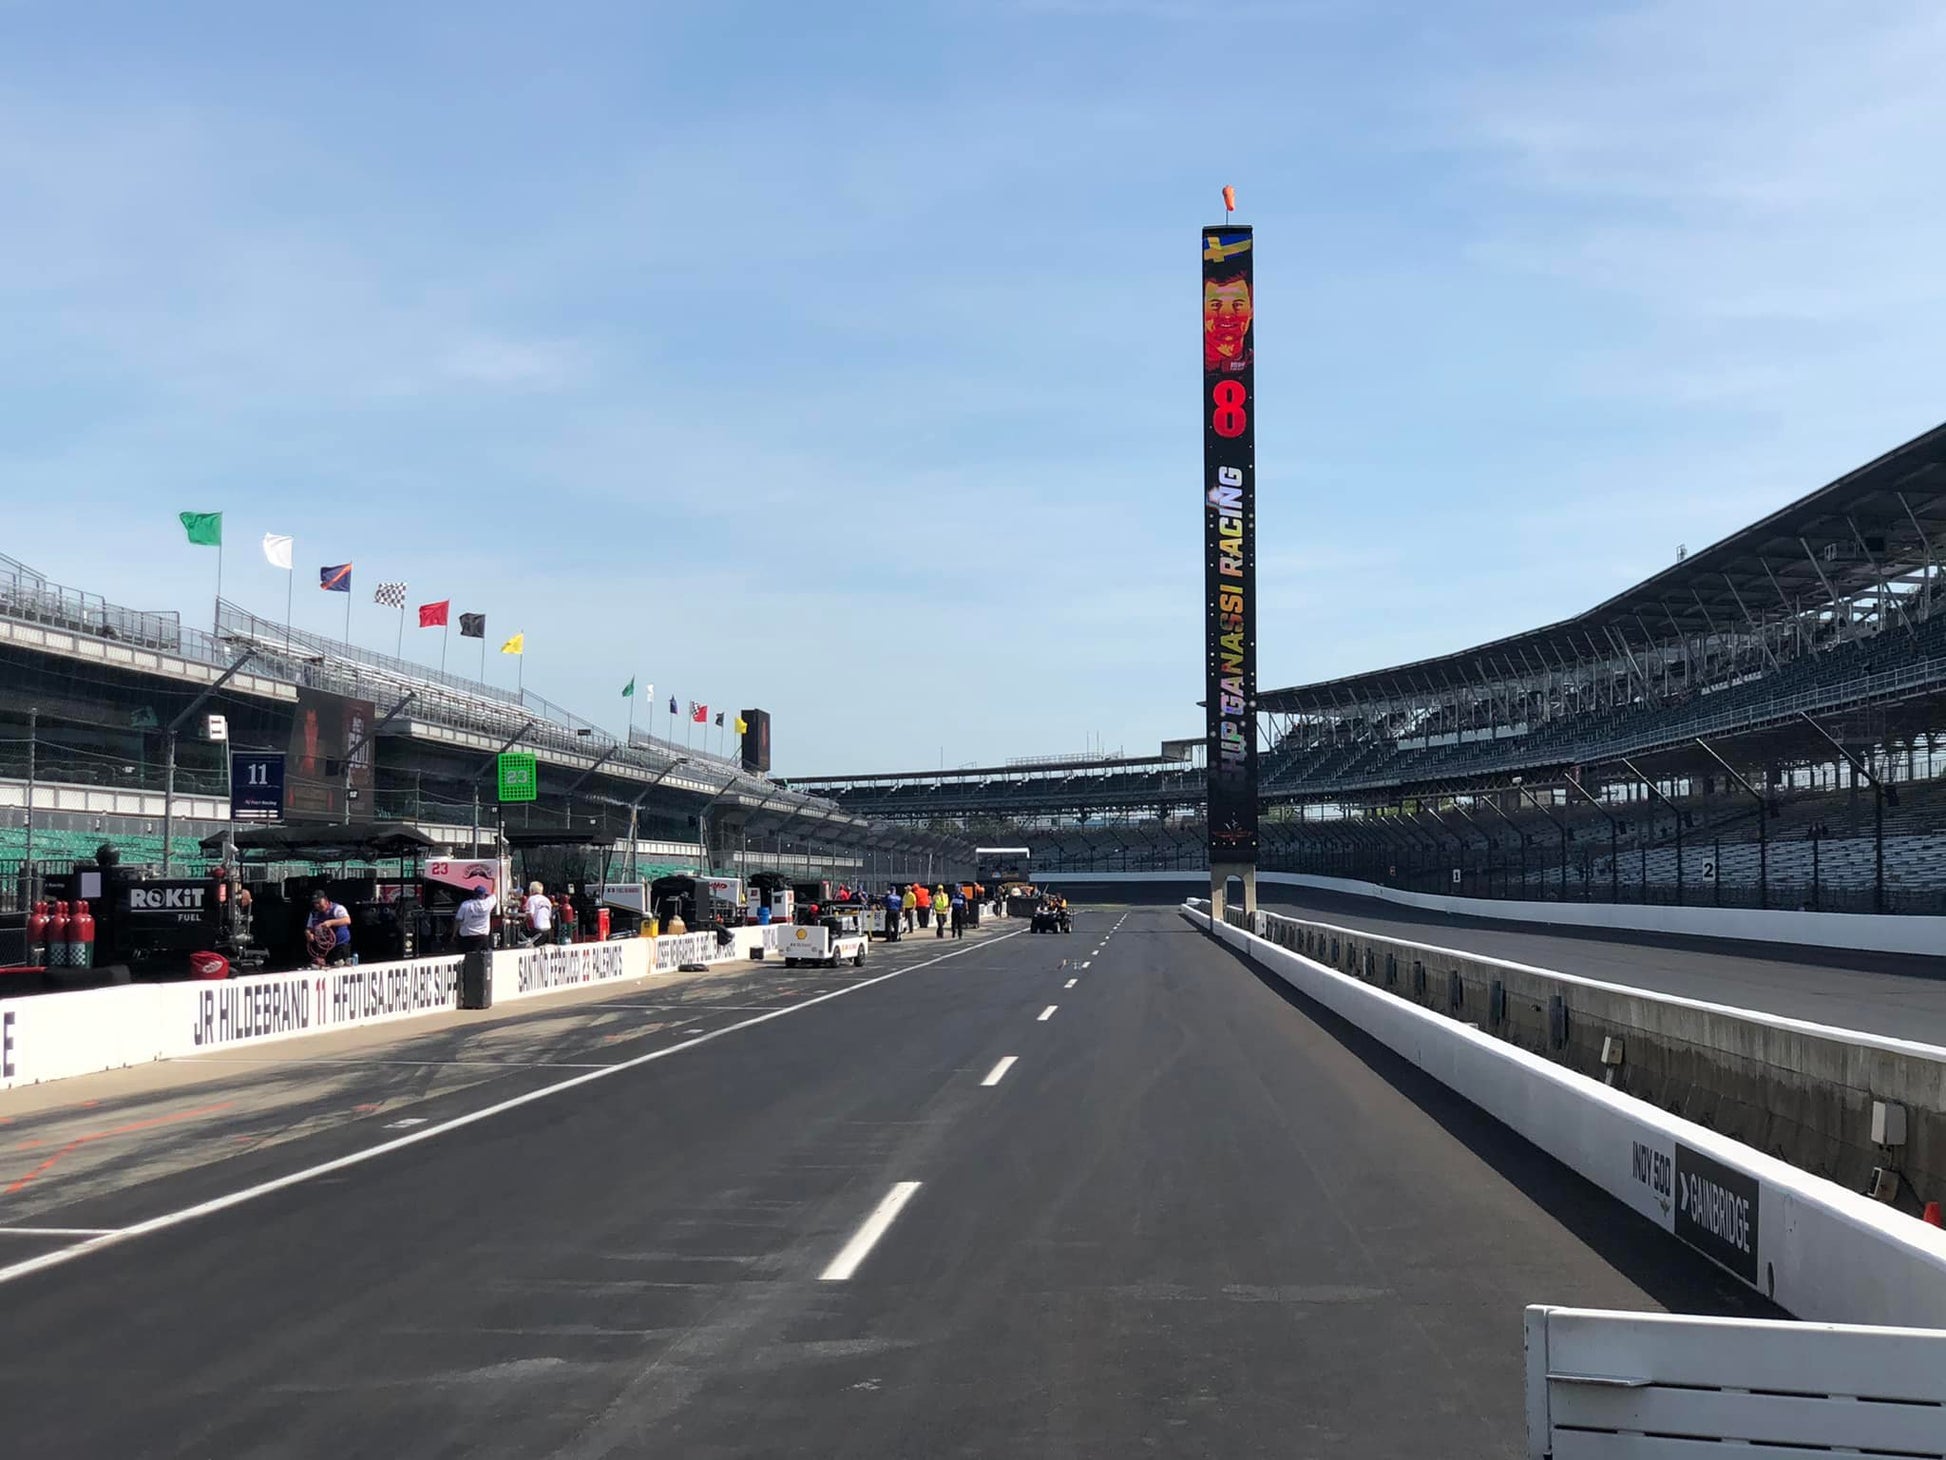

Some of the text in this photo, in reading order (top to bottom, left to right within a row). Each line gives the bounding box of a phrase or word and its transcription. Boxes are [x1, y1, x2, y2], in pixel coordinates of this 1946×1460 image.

[1213, 380, 1247, 438] 8
[1218, 466, 1243, 578] RACING
[1219, 583, 1244, 716] GANASSI
[248, 763, 268, 785] 11
[506, 770, 528, 785] 23
[432, 862, 449, 875] 23
[1704, 862, 1713, 878] 2
[130, 888, 205, 908] ROKiT
[177, 913, 202, 922] FUEL
[518, 951, 549, 993] SANTINO
[583, 949, 591, 982] 23
[194, 989, 214, 1046] JR
[219, 979, 309, 1042] HILDEBRAND
[316, 977, 327, 1026] 11
[0, 1011, 15, 1078] E
[1632, 1140, 1671, 1198] INDY 500
[1690, 1173, 1750, 1255] GAINBRIDGE
